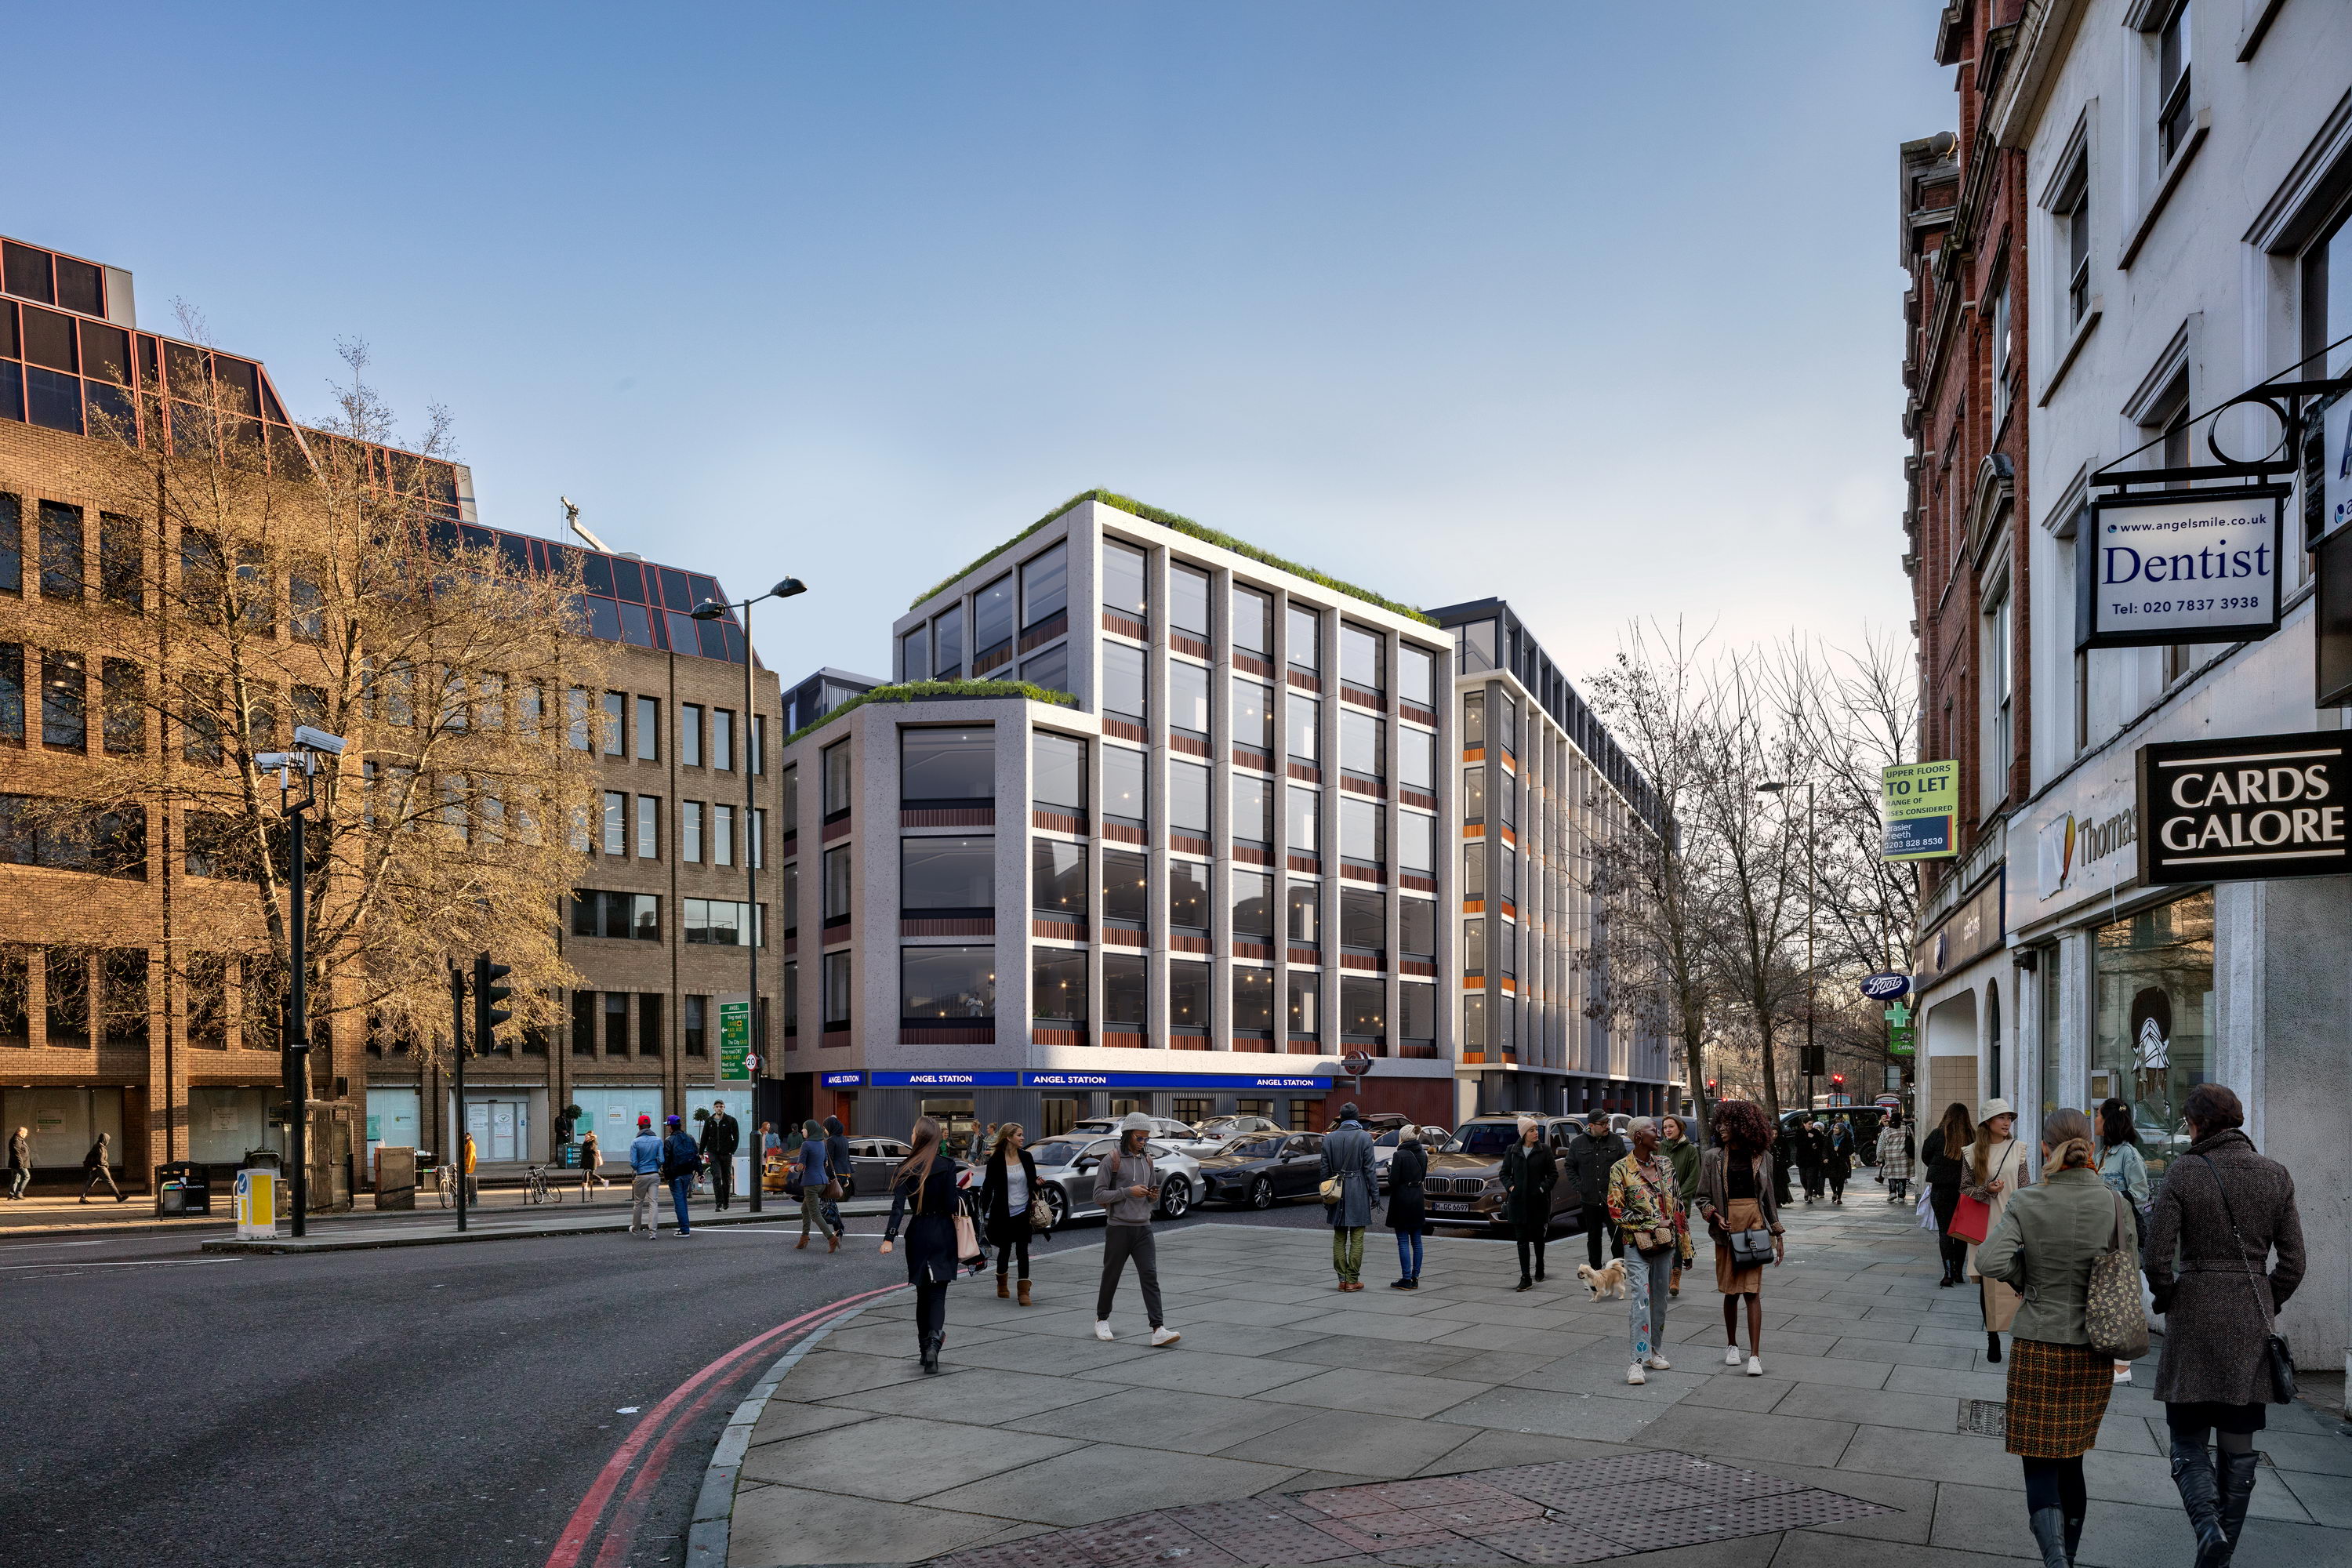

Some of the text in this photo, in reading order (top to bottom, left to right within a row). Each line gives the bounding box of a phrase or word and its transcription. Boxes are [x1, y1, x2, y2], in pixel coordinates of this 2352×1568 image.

[2121, 514, 2267, 532] www.angelsmile.co.uk
[2102, 539, 2270, 584] Dentist
[2112, 597, 2259, 614] Tel: 020 7837 3938
[1886, 764, 1951, 779] UPPER FLOORS
[1886, 776, 1949, 797] TO LET
[2171, 764, 2330, 808] CARDS
[1886, 798, 1911, 807] RANGE
[1906, 804, 1953, 815] CONSIDERED
[1885, 823, 1912, 832] brasier
[1886, 831, 1911, 840] freeth
[2161, 806, 2345, 851] GALORE
[1884, 837, 1943, 849] 0203 828 8530
[1865, 975, 1903, 995] Boots
[747, 1058, 755, 1066] 20
